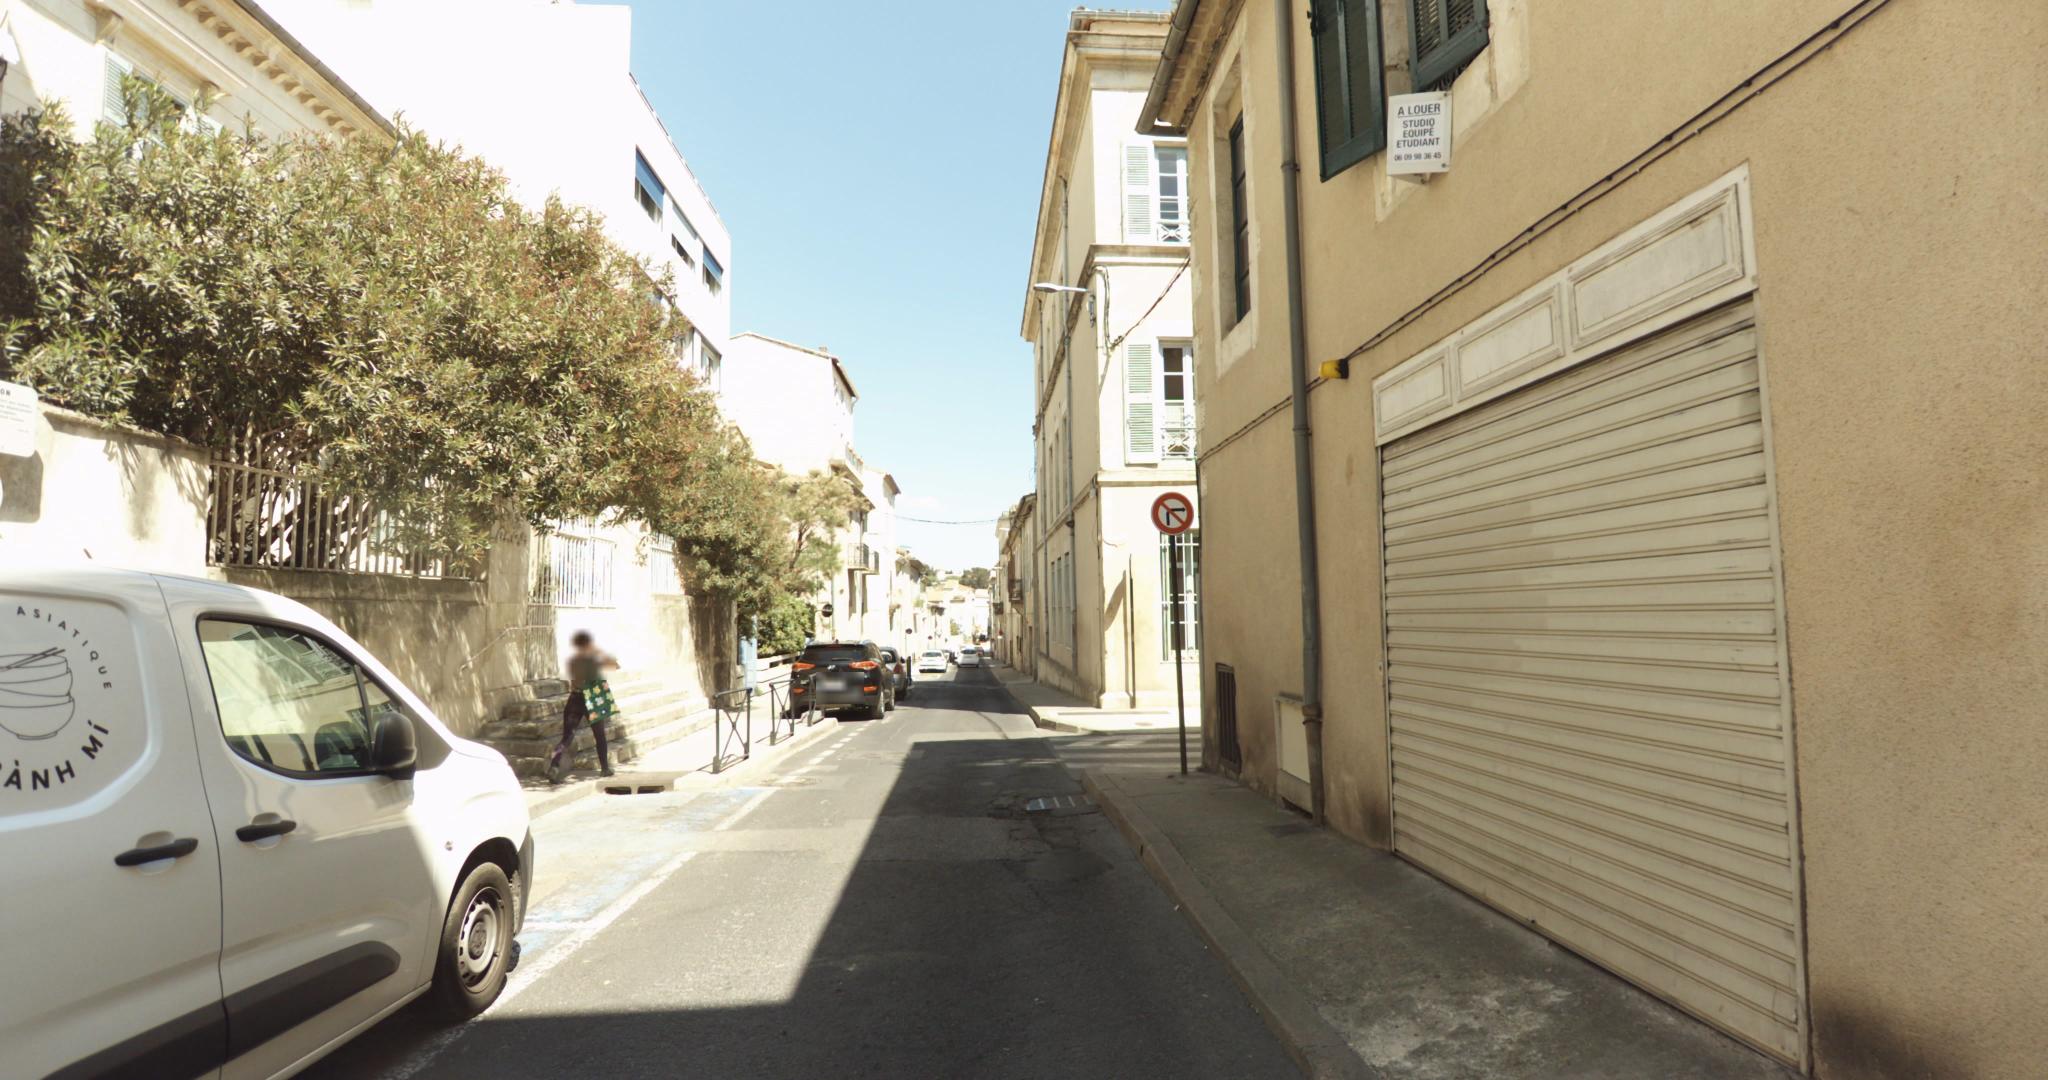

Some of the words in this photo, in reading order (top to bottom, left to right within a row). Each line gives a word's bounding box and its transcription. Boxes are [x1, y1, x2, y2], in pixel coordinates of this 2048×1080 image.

[1398, 106, 1405, 115] A
[1408, 103, 1441, 114] LOUER
[1402, 118, 1435, 128] STUDIO
[1397, 137, 1440, 148] ETUDIANT
[1433, 151, 1442, 159] 45
[16, 606, 112, 689] ASIATIQUE
